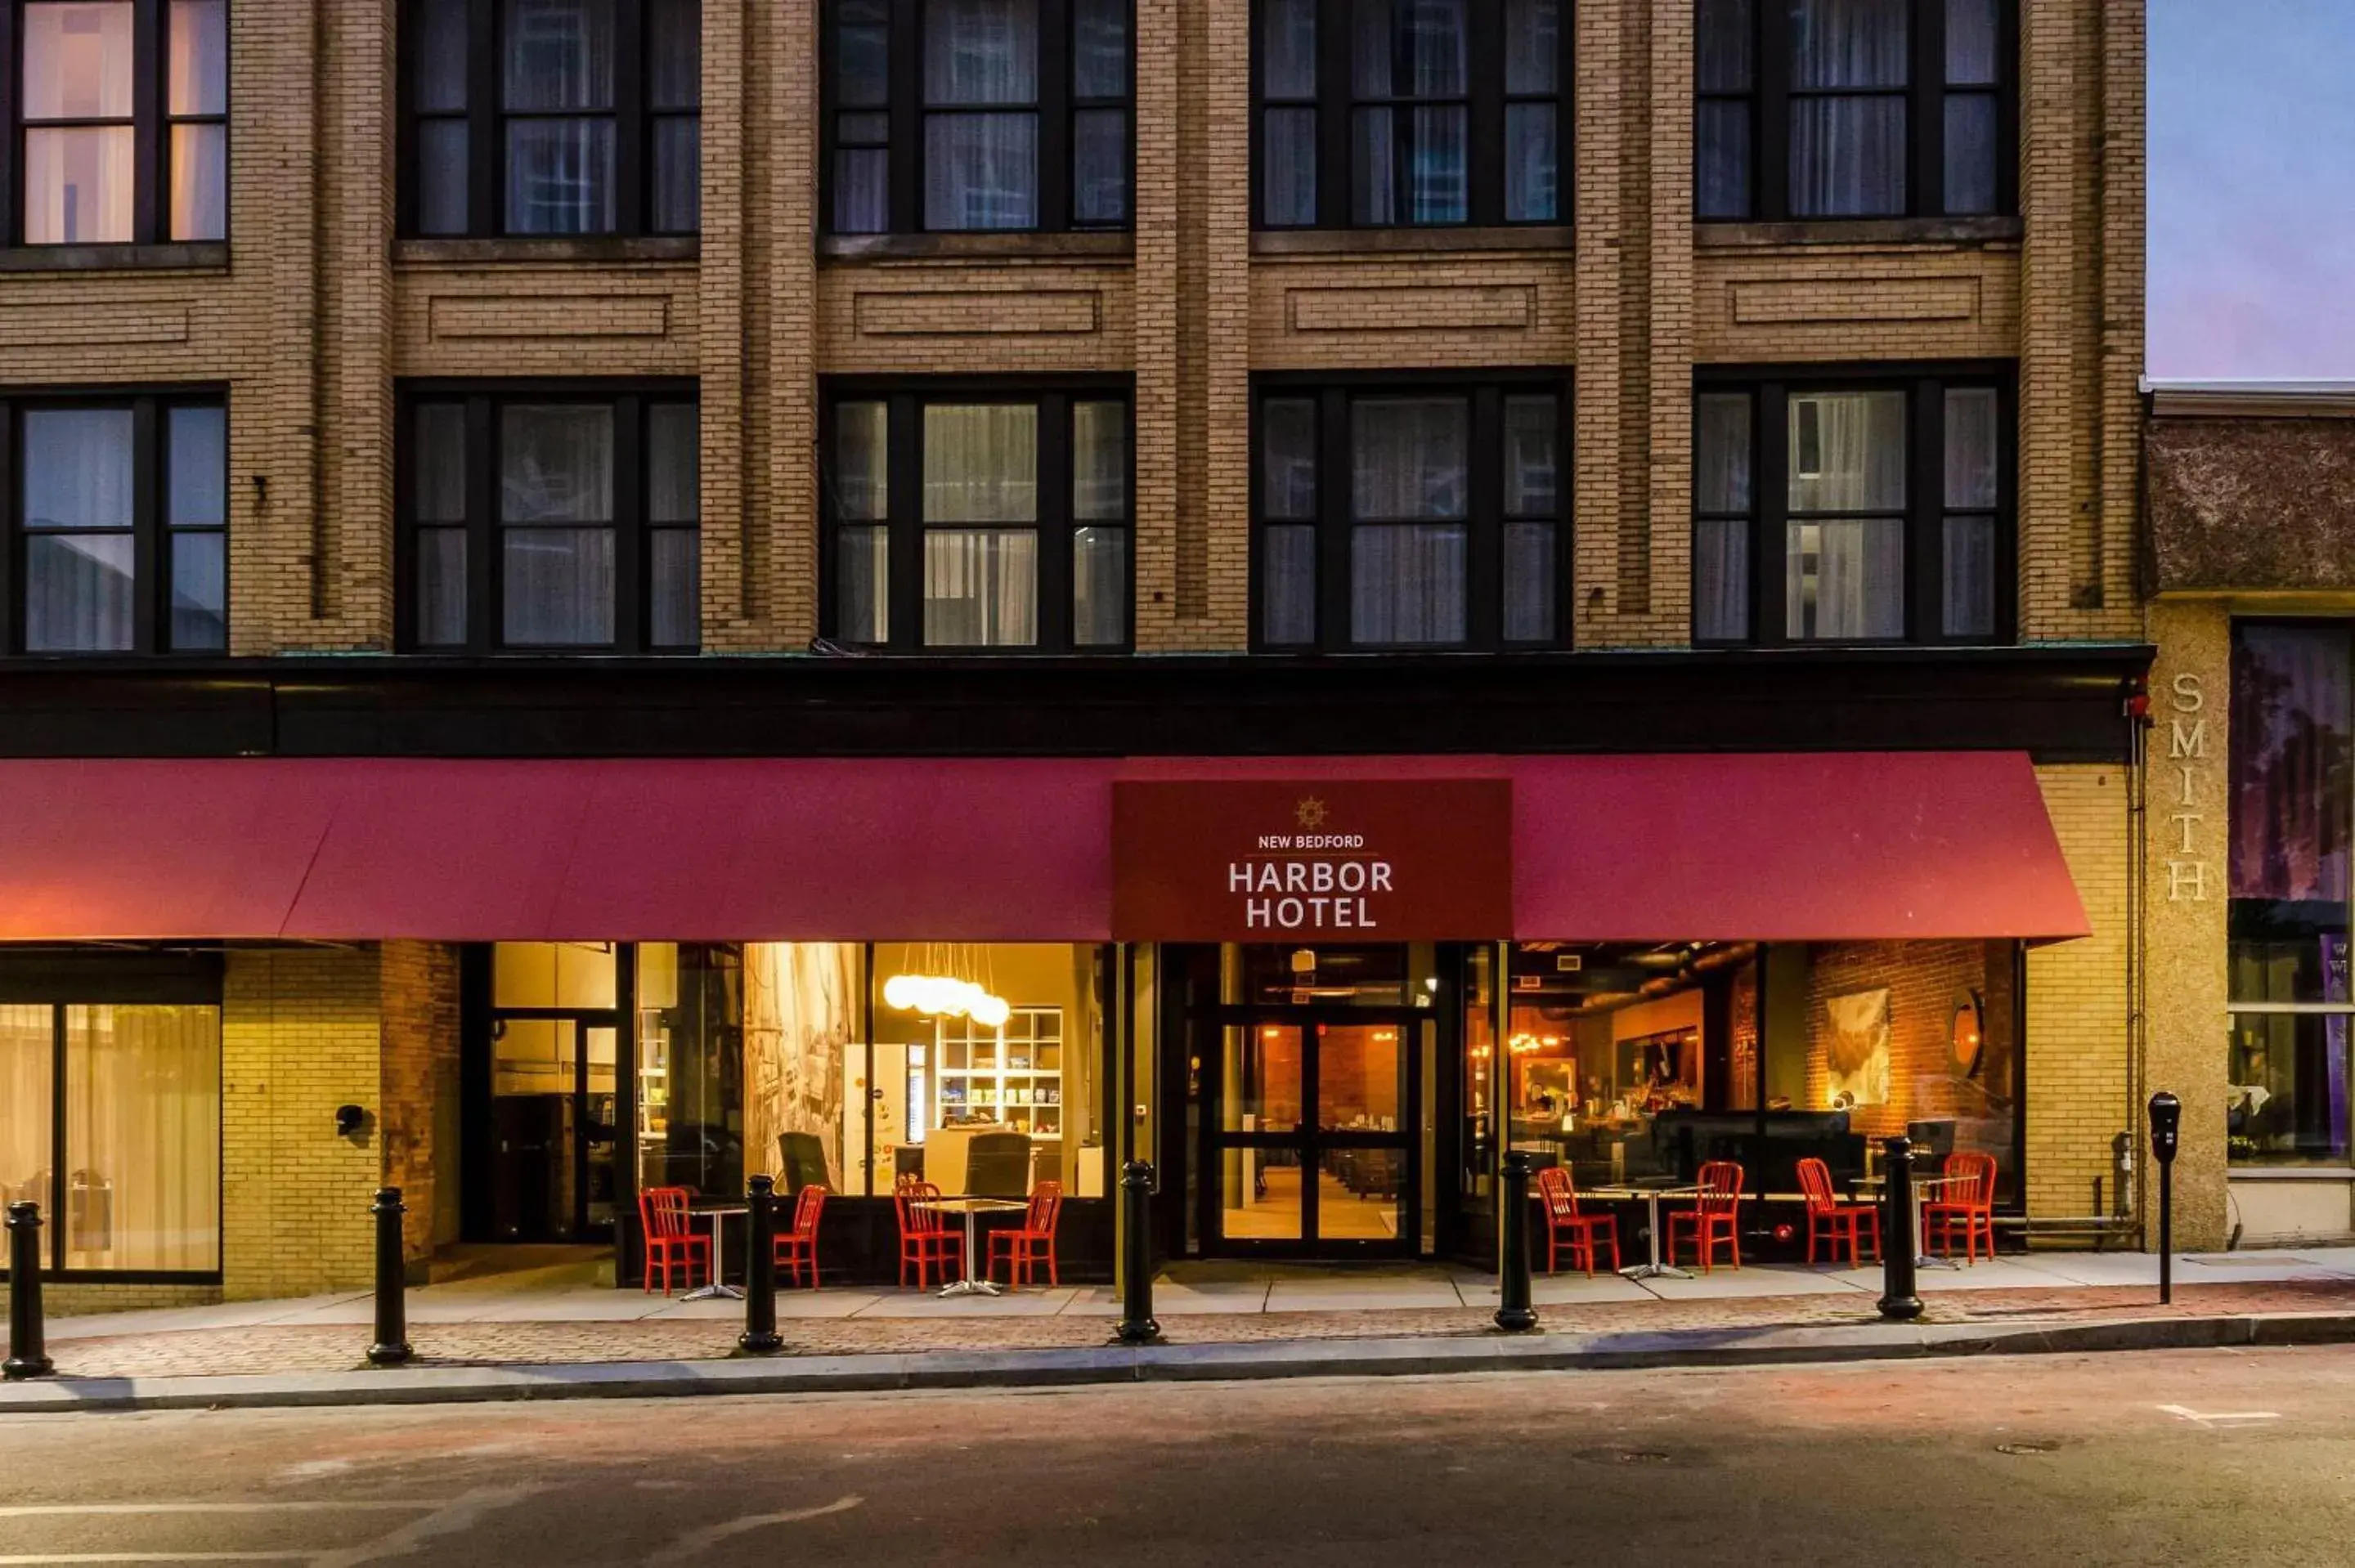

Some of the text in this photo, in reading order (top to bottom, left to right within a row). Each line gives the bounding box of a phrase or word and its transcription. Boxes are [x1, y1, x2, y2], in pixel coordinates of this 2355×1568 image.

[2169, 672, 2206, 901] SMITH
[1258, 835, 1364, 849] NEW BEDFORD
[1229, 862, 1393, 893] HARBOR
[1247, 898, 1377, 928] HOTEL
